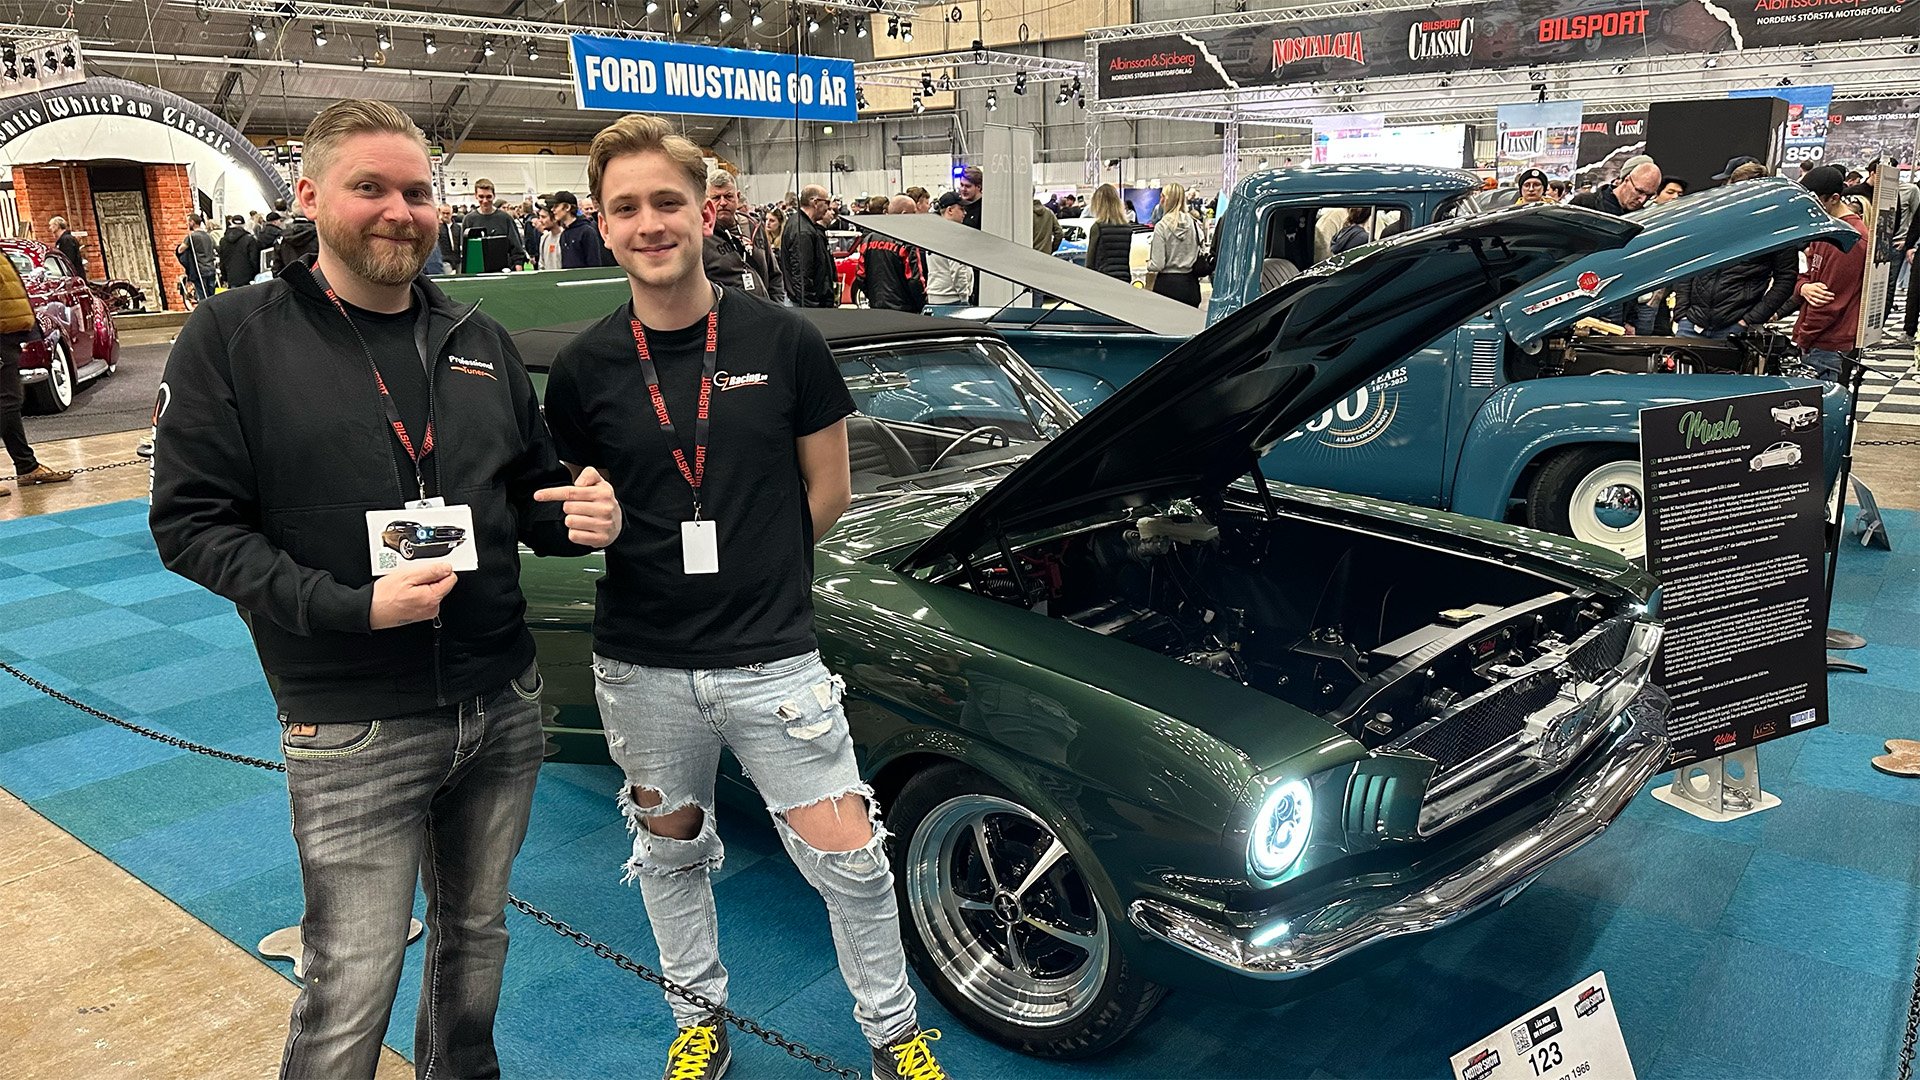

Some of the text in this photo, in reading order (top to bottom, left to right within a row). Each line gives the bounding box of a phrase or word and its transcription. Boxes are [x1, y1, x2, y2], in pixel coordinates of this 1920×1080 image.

[1422, 19, 1461, 31] BILSPORT
[1538, 9, 1650, 43] BILSPORT
[1756, 5, 1902, 26] NORDENS STÖRSTA MOTORFÖRLAG
[1271, 32, 1365, 72] NOSTALGIA
[1408, 17, 1474, 60] CLASSIC
[585, 55, 847, 106] FORD MUSTANG 60 ÅR
[1112, 68, 1192, 81] NORDENS STÖRSTA MOTORFÖRLAG
[162, 106, 232, 154] Classic
[1786, 146, 1824, 161] 850
[630, 320, 650, 360] BILSPORT
[706, 311, 718, 352] BILSPORT
[698, 377, 712, 420] BILSPORT
[1371, 376, 1408, 392] 1873-2023
[649, 384, 670, 425] BILSPORT
[1336, 435, 1356, 443] ATLAS
[1678, 405, 1741, 449] Musla
[1528, 1042, 1563, 1076] 123
[1571, 1061, 1591, 1080] 1966
